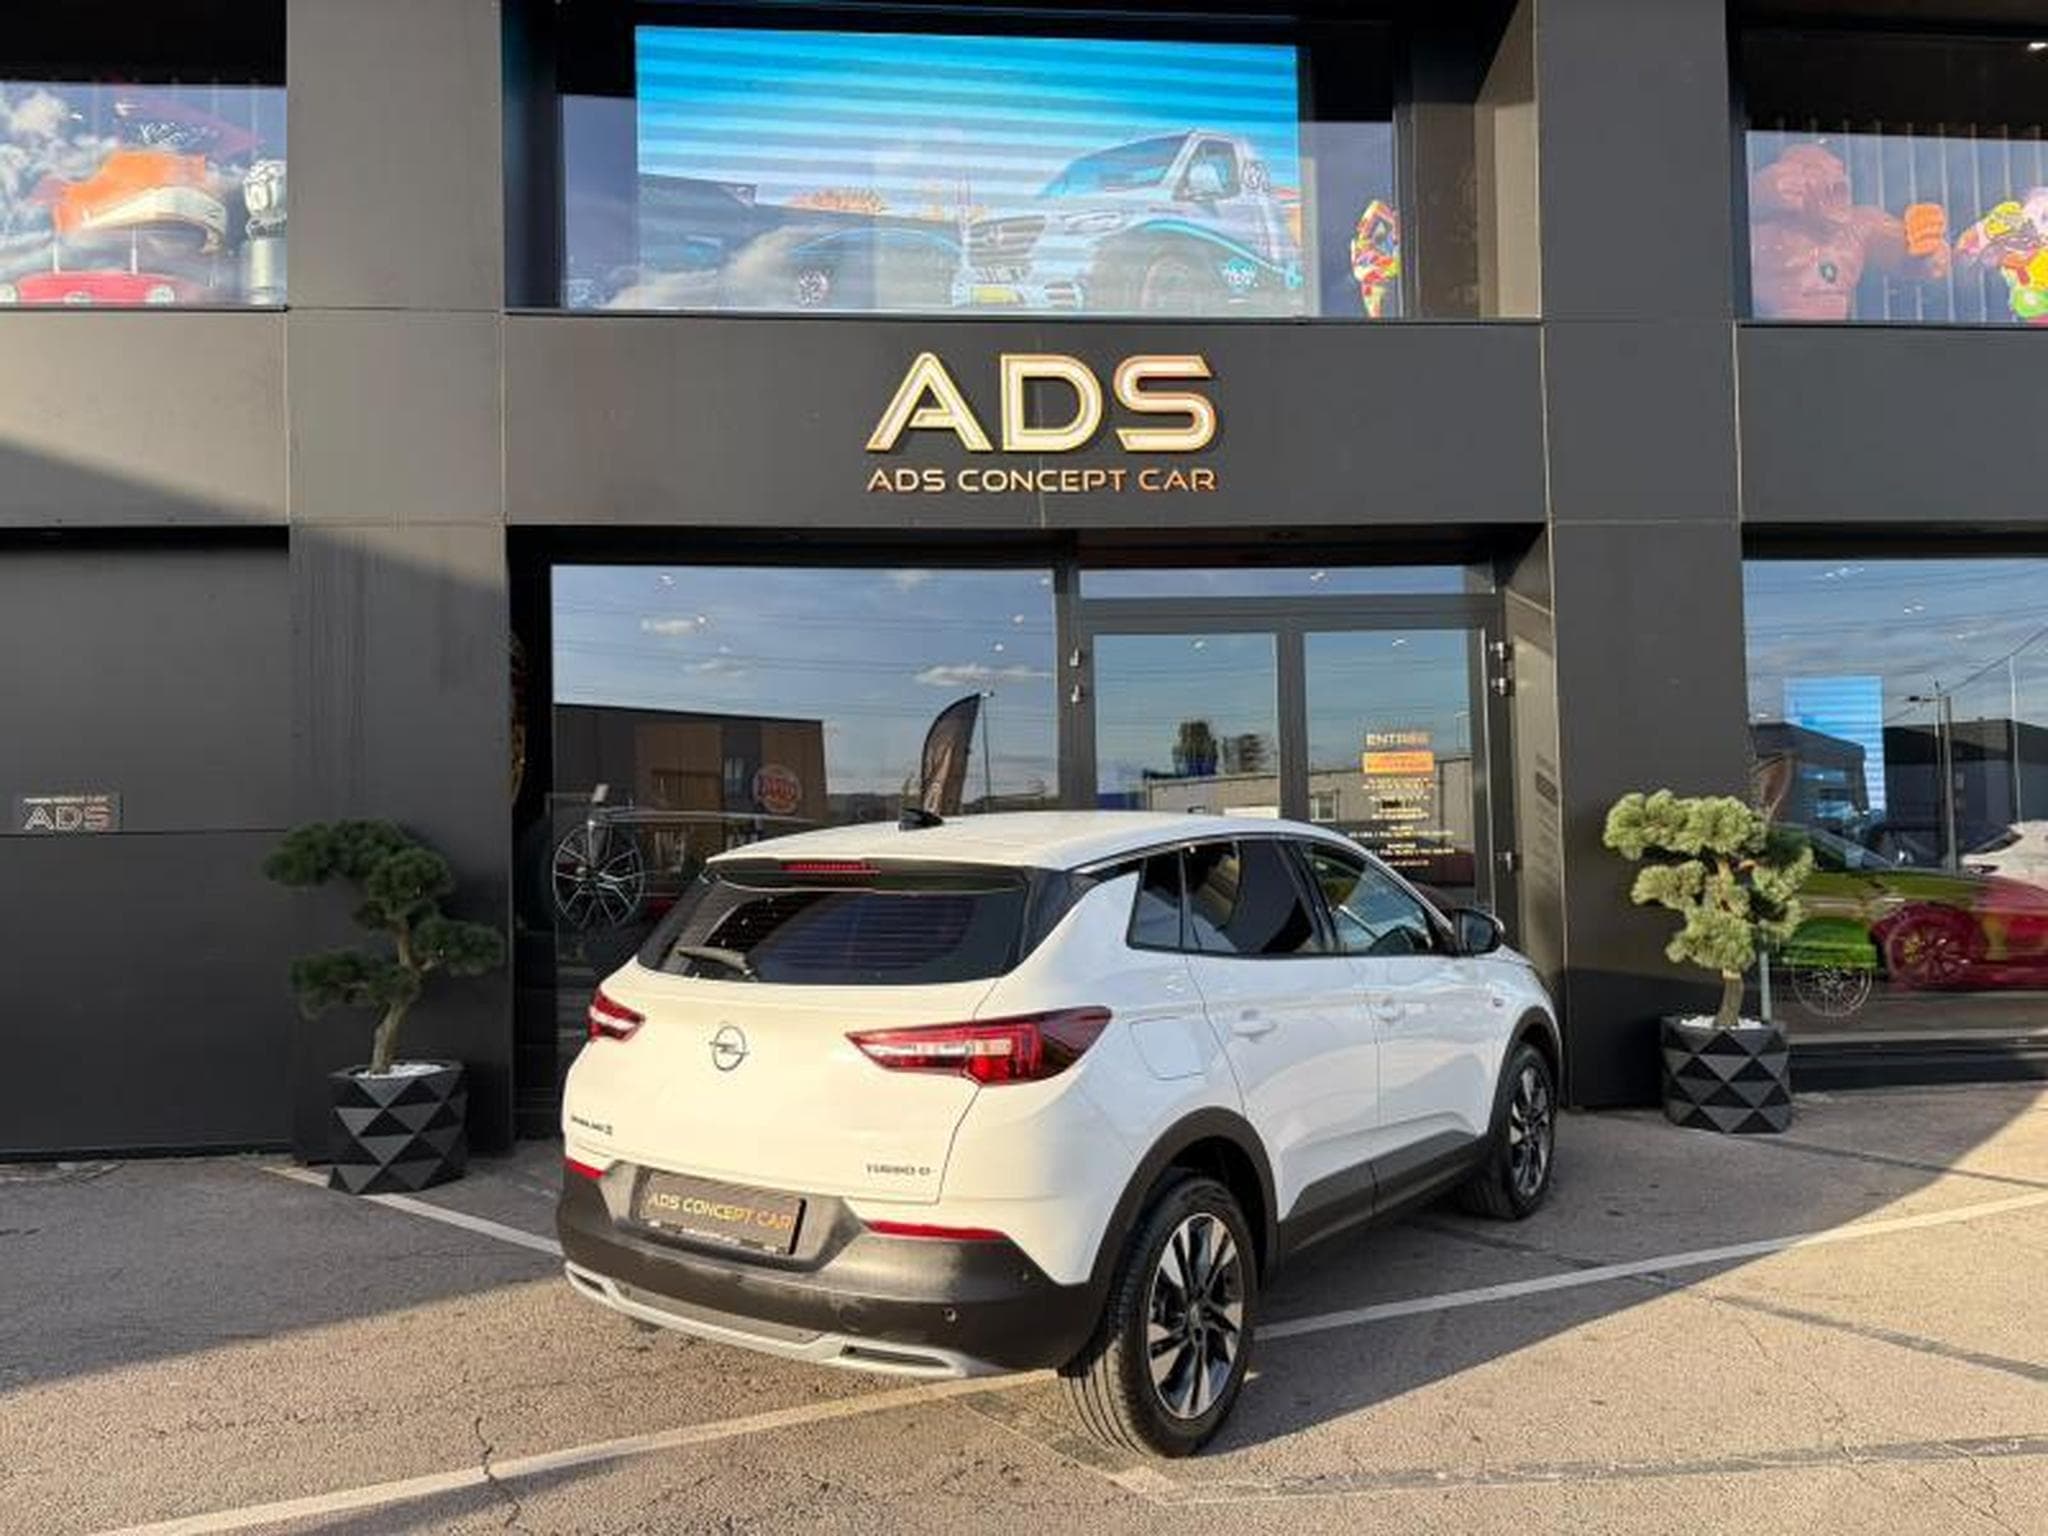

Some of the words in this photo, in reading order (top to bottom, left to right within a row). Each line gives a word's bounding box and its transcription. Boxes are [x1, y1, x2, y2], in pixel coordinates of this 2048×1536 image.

[865, 352, 1216, 451] ADS
[866, 469, 944, 492] ADS
[958, 469, 1126, 492] CONCEPT
[1138, 469, 1215, 491] CAR
[24, 806, 111, 830] ADS
[649, 1192, 680, 1209] ADS
[682, 1198, 754, 1224] CONCEPT
[757, 1210, 793, 1231] CAR
